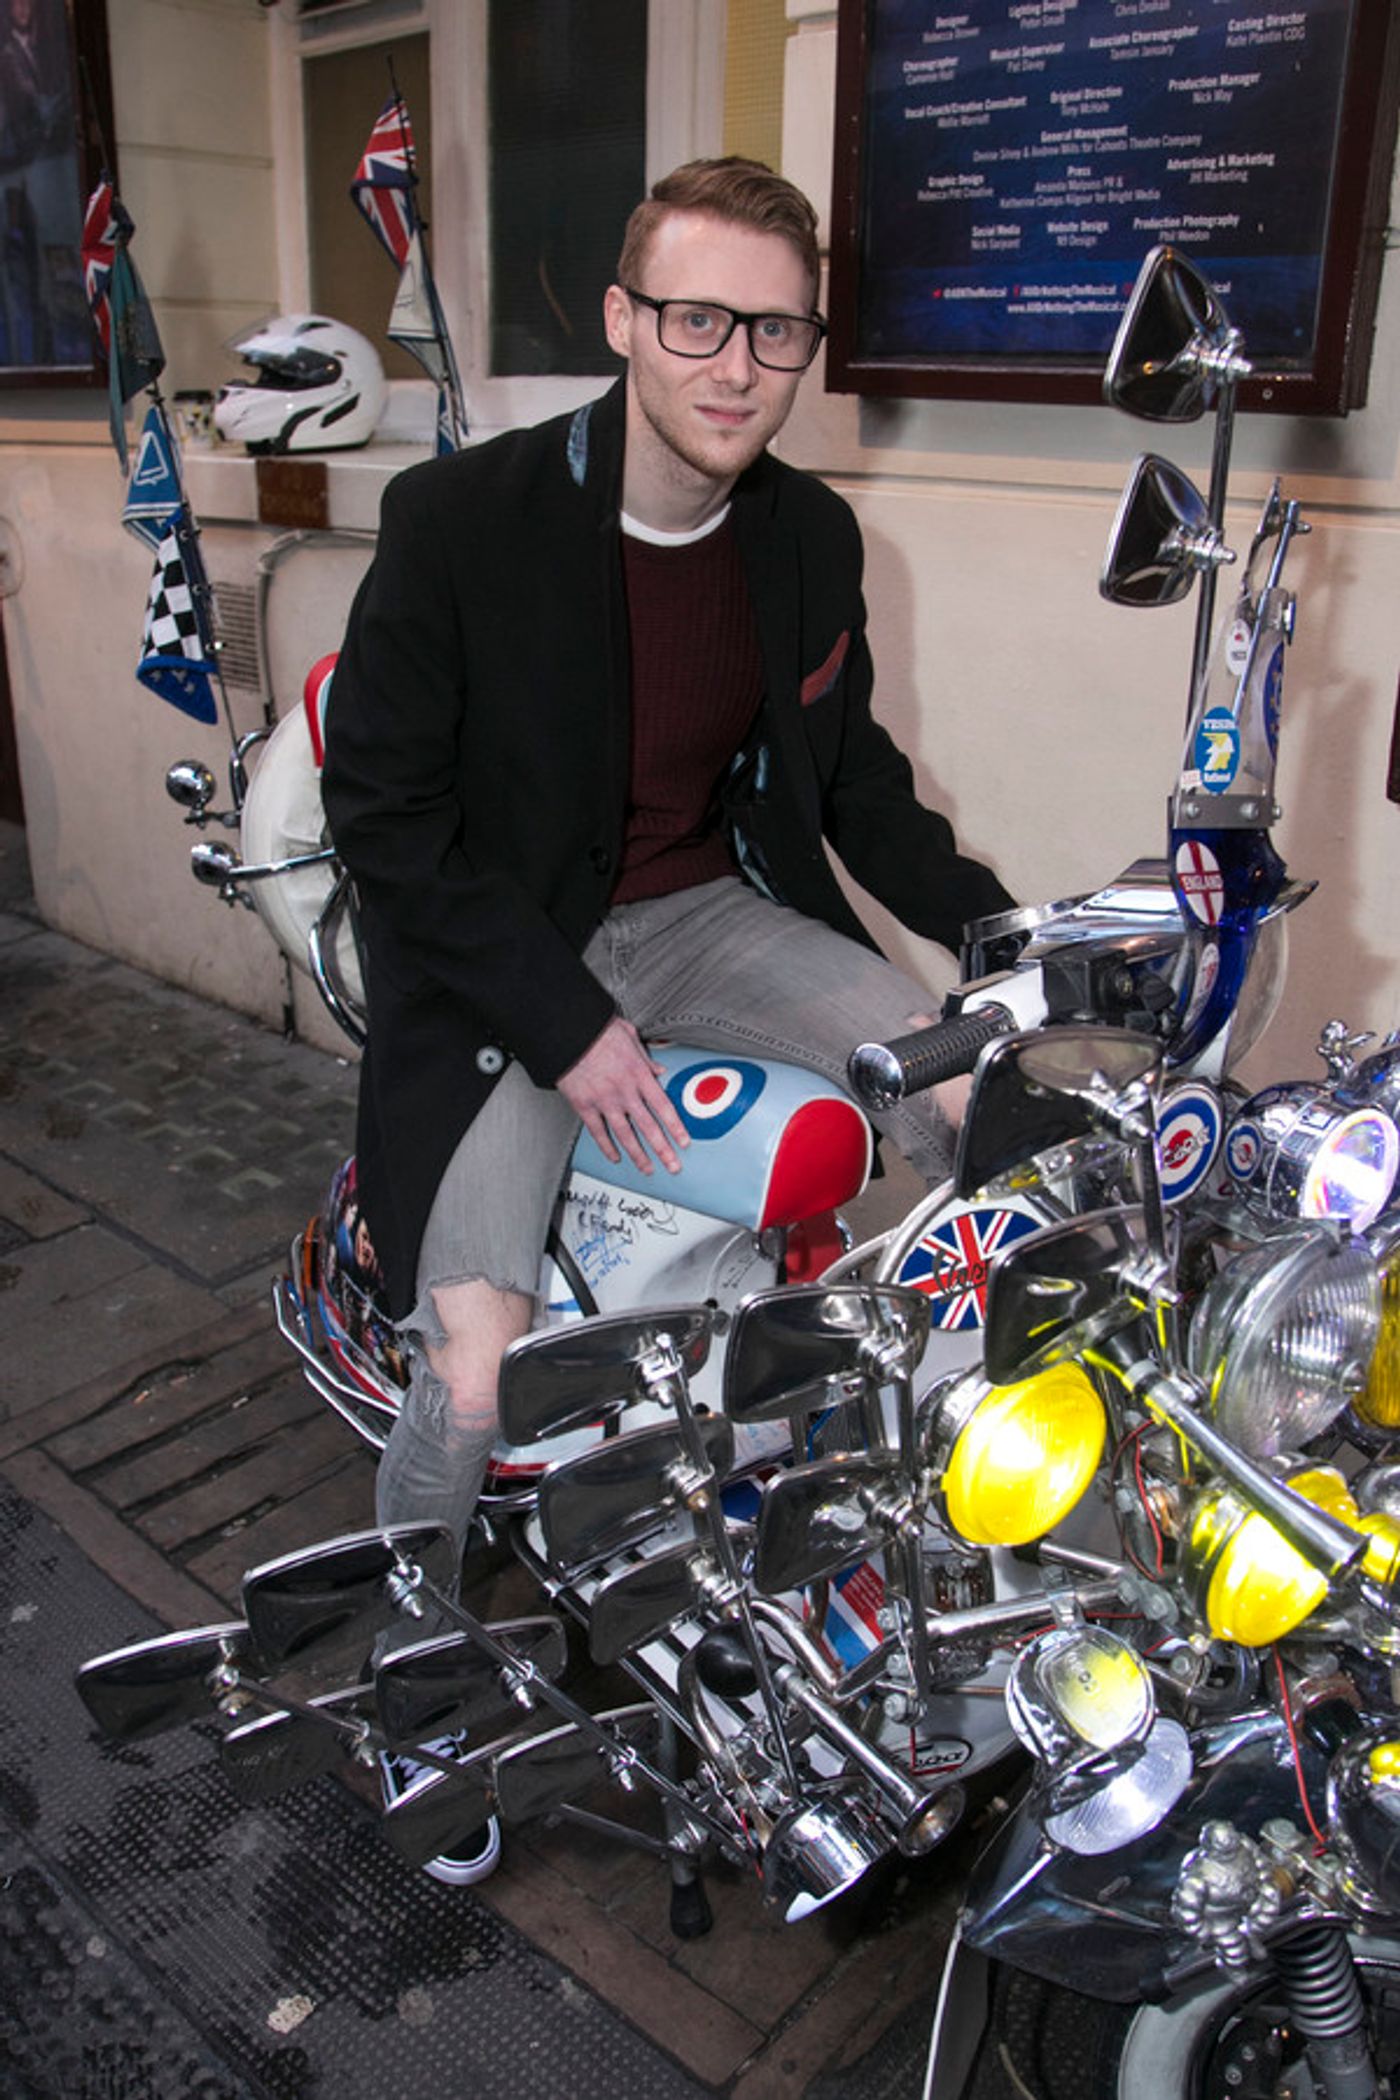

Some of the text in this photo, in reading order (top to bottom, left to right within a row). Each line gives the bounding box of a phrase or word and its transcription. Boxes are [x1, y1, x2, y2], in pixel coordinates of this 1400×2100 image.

[1228, 13, 1306, 31] Casting Director
[1089, 26, 1198, 48] Associate Choreographer
[1169, 73, 1260, 92] Production Manager
[1050, 87, 1122, 106] Original Direction
[1193, 92, 1212, 103] Nick
[1041, 126, 1127, 142] General Management
[1023, 147, 1030, 158] &
[1130, 137, 1161, 149] Theatre
[1162, 135, 1202, 147] Company
[1167, 153, 1274, 170] Advertising & Marketing
[1067, 166, 1091, 176] Press
[1204, 170, 1247, 182] Marketing
[1135, 189, 1160, 200] Media
[1047, 221, 1108, 233] Website Design
[1133, 214, 1239, 229] Production Photography
[972, 225, 1020, 237] Social Media
[1069, 235, 1096, 247] Design
